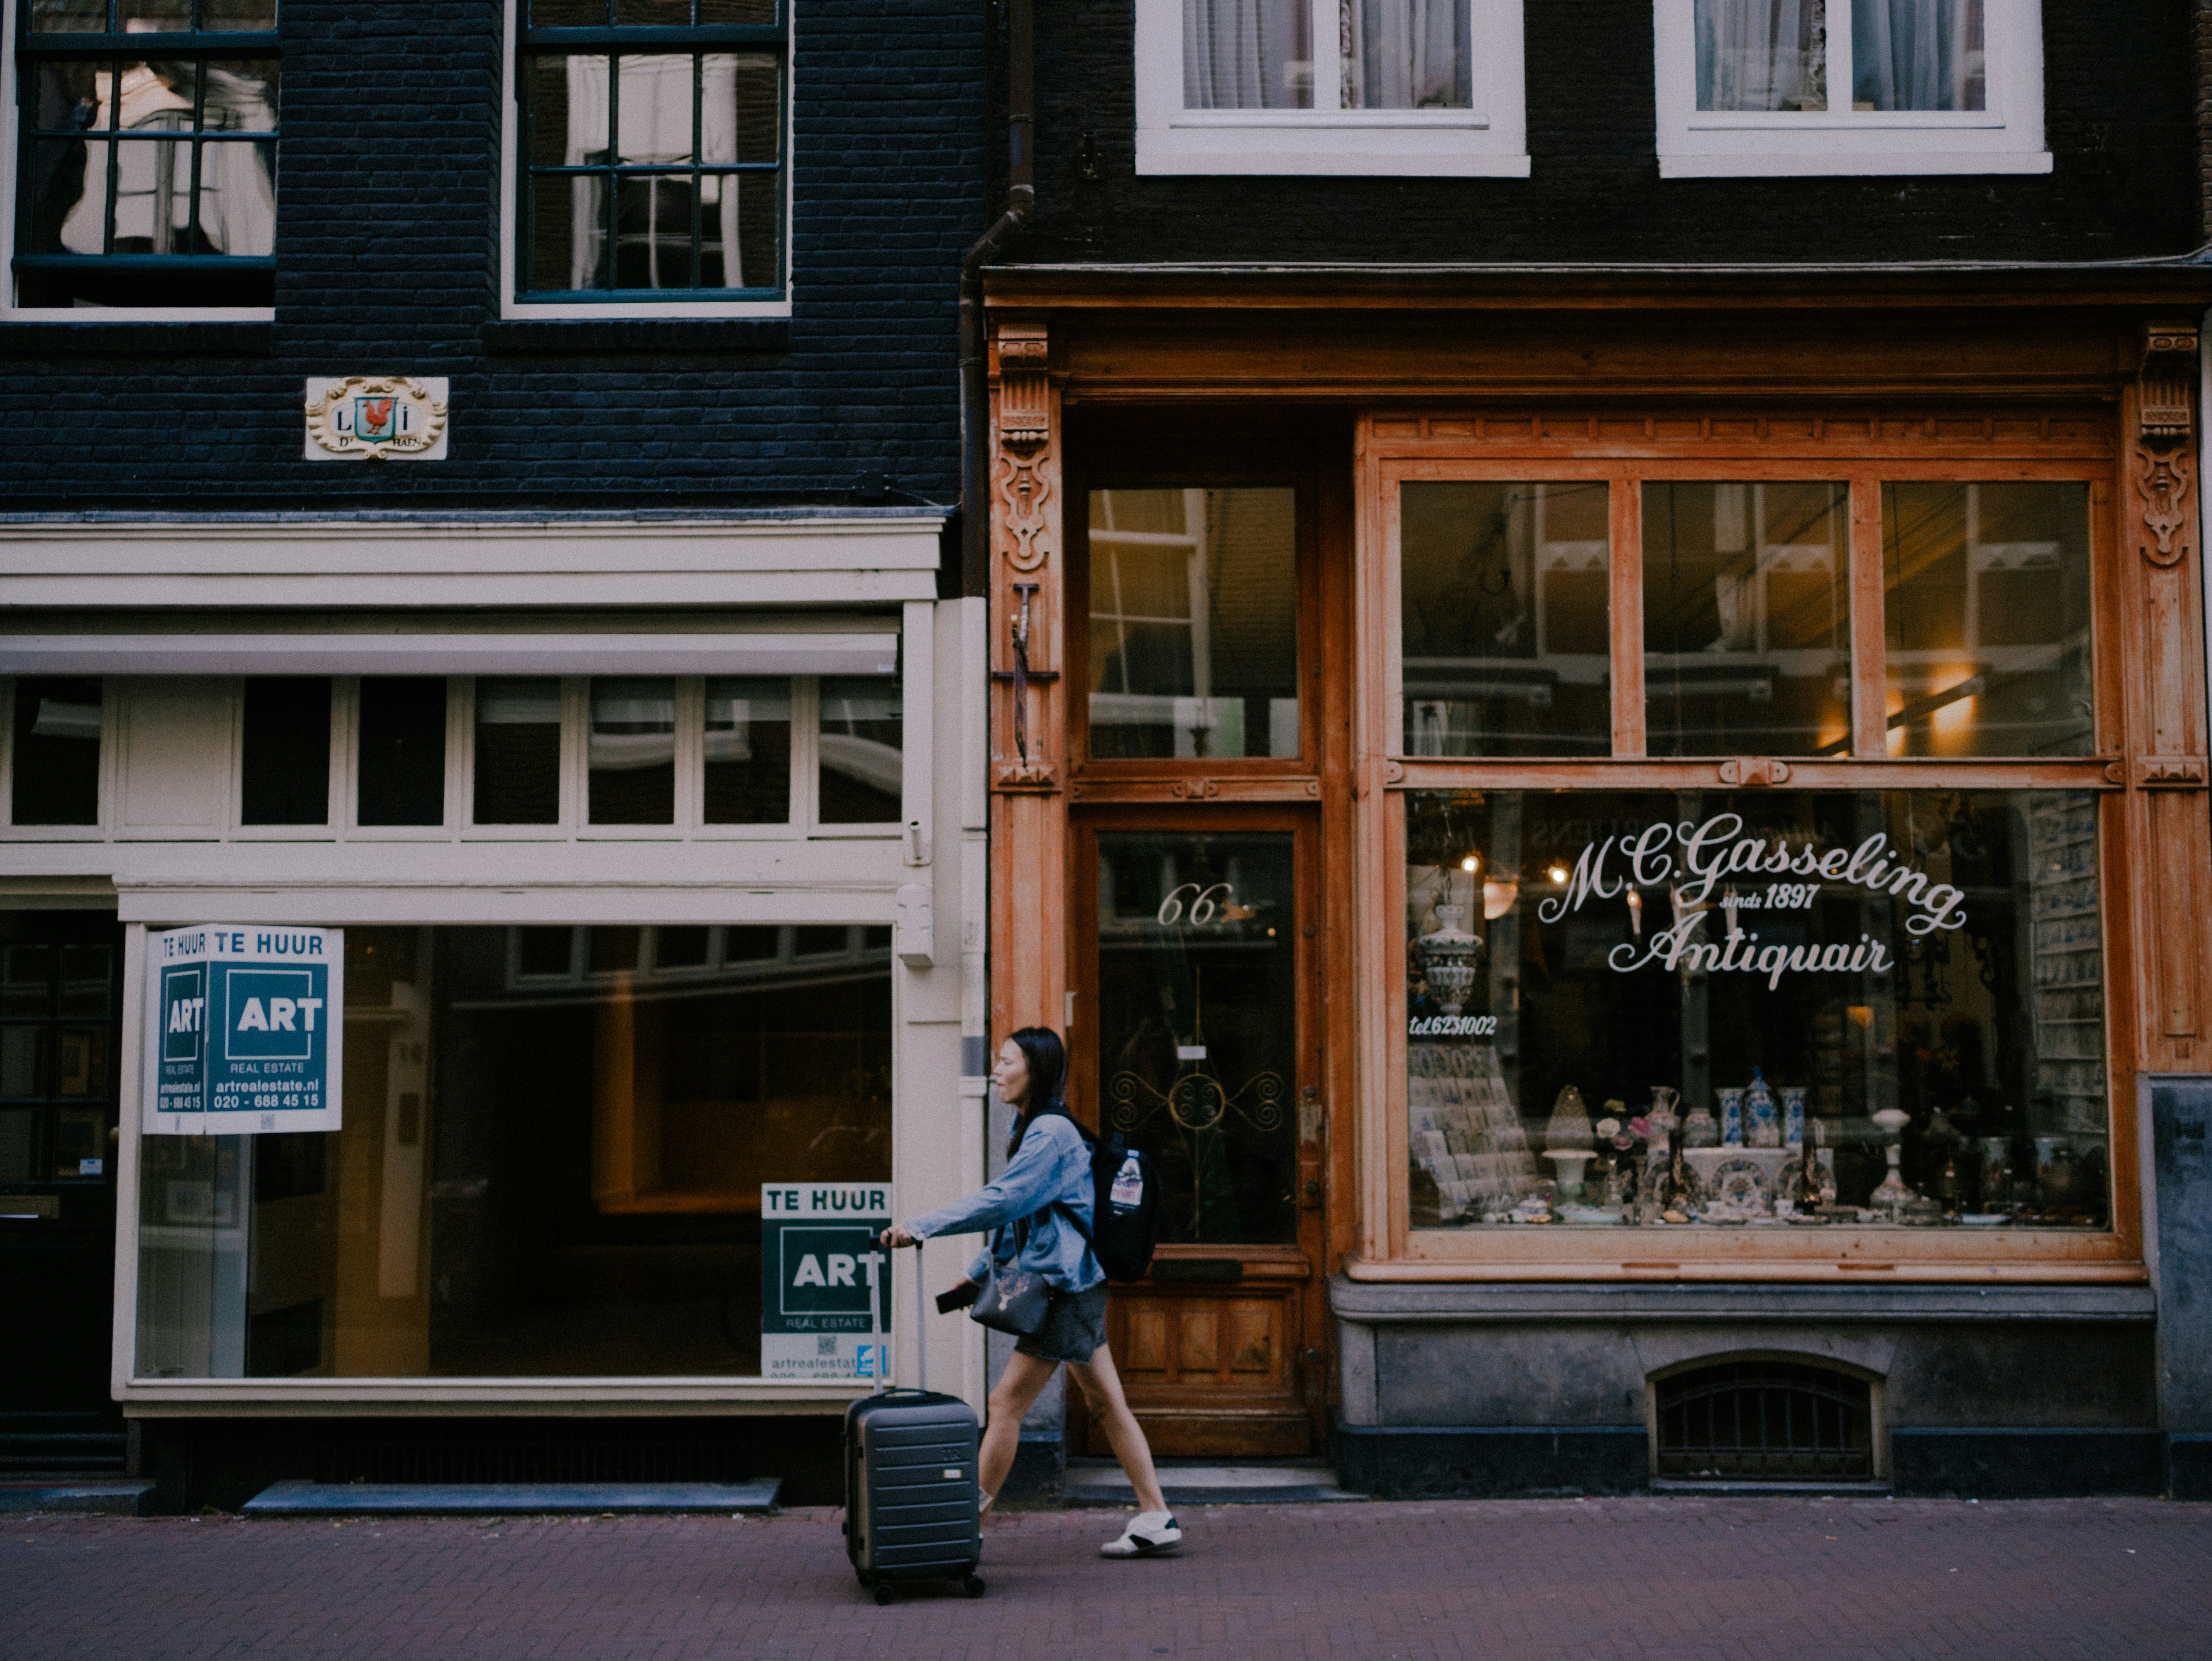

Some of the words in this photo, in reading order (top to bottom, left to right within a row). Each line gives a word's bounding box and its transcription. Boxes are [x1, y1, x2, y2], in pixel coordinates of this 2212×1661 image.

[338, 411, 352, 431] L
[1158, 883, 1233, 926] 66
[1719, 891, 1762, 909] sinds
[1764, 884, 1820, 909] 1897
[164, 938, 173, 956] TE
[178, 933, 205, 954] HUUR
[215, 932, 244, 952] TE
[257, 934, 323, 954] HUUR
[1608, 911, 1894, 991] Antiquair
[169, 997, 204, 1033] ART
[237, 997, 322, 1031] ART
[230, 1063, 259, 1074] REAL
[264, 1062, 304, 1073] ESTATE
[216, 1079, 318, 1093] artrealestate.nl
[193, 1096, 201, 1109] 15
[214, 1096, 239, 1108] 020
[254, 1095, 279, 1107] 688
[283, 1095, 299, 1106] 45
[303, 1094, 318, 1106] 15
[767, 1191, 799, 1210] TE
[812, 1191, 885, 1210] HUUR
[793, 1254, 886, 1286] ART
[786, 1318, 817, 1328] REAL
[822, 1318, 865, 1328] ESTATE
[771, 1358, 855, 1368] artrealestat
